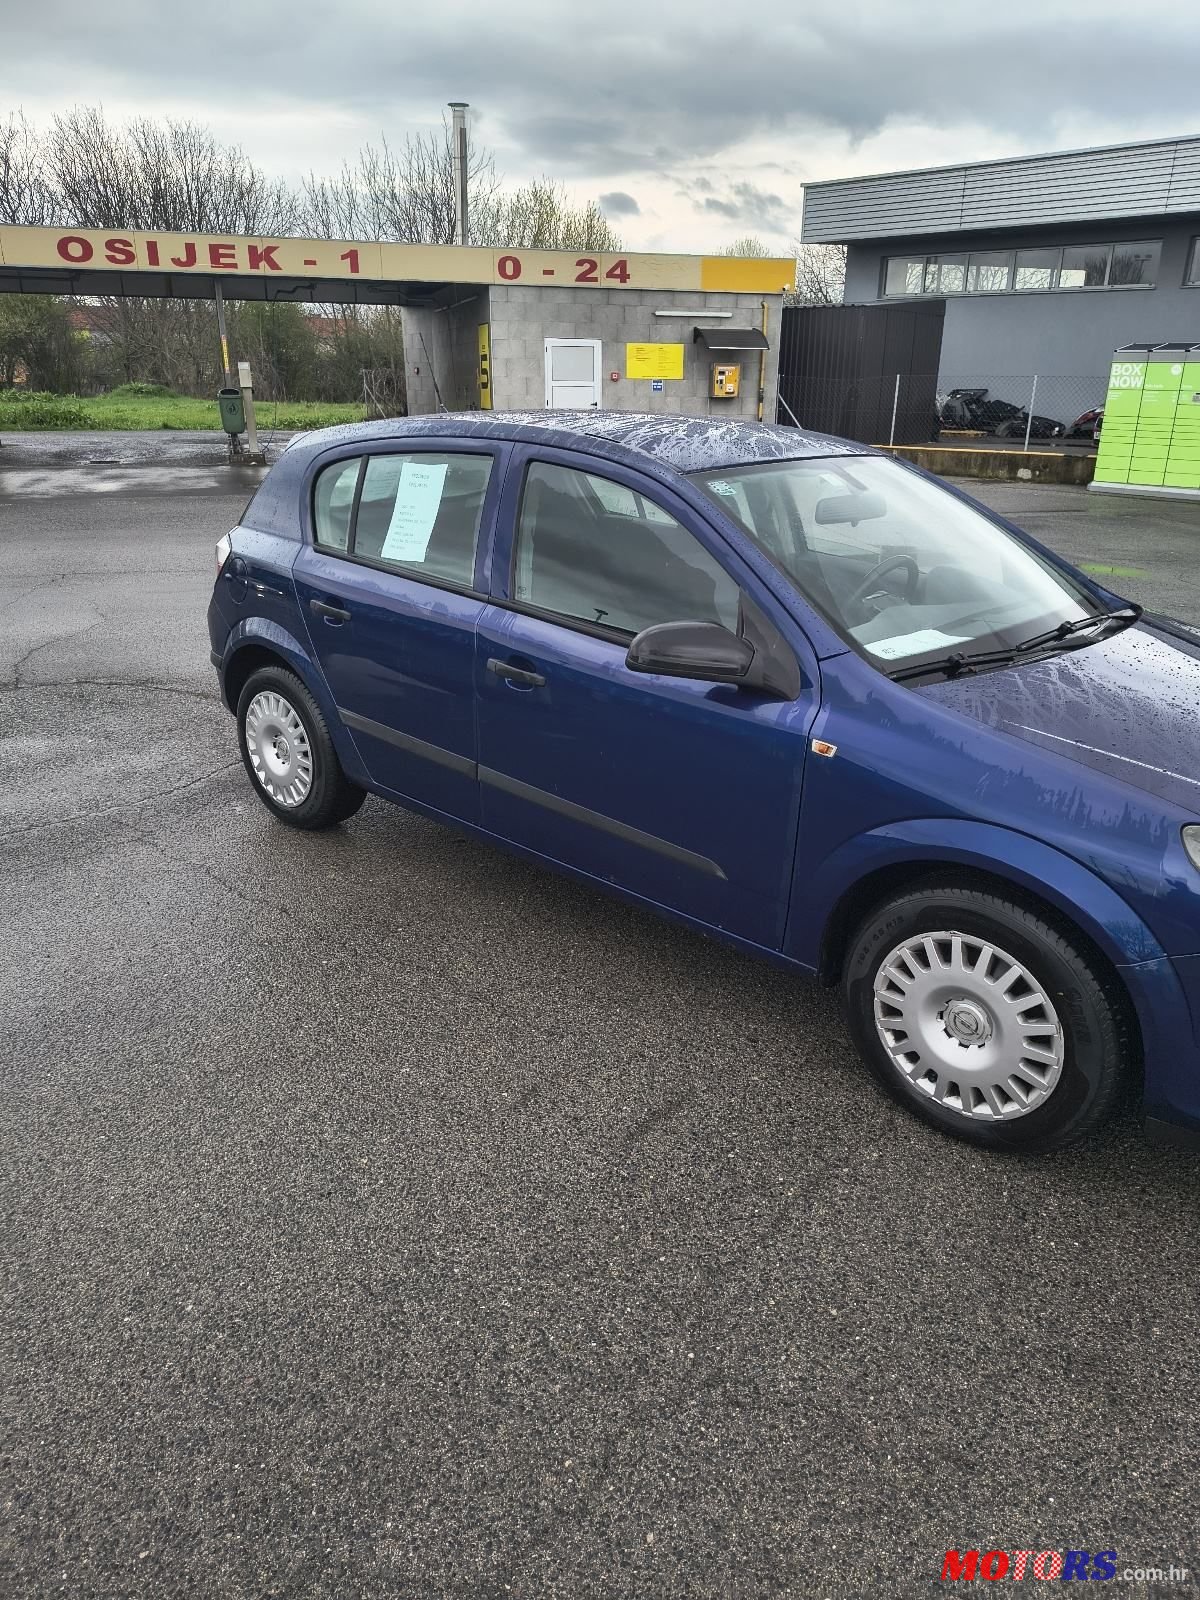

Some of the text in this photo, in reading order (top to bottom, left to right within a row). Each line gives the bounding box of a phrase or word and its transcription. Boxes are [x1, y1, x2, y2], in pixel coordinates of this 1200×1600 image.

[56, 235, 283, 271] OSIJEK
[340, 248, 361, 274] 1
[574, 258, 631, 284] 24
[1111, 363, 1143, 376] BOX
[1109, 376, 1144, 388] NOW
